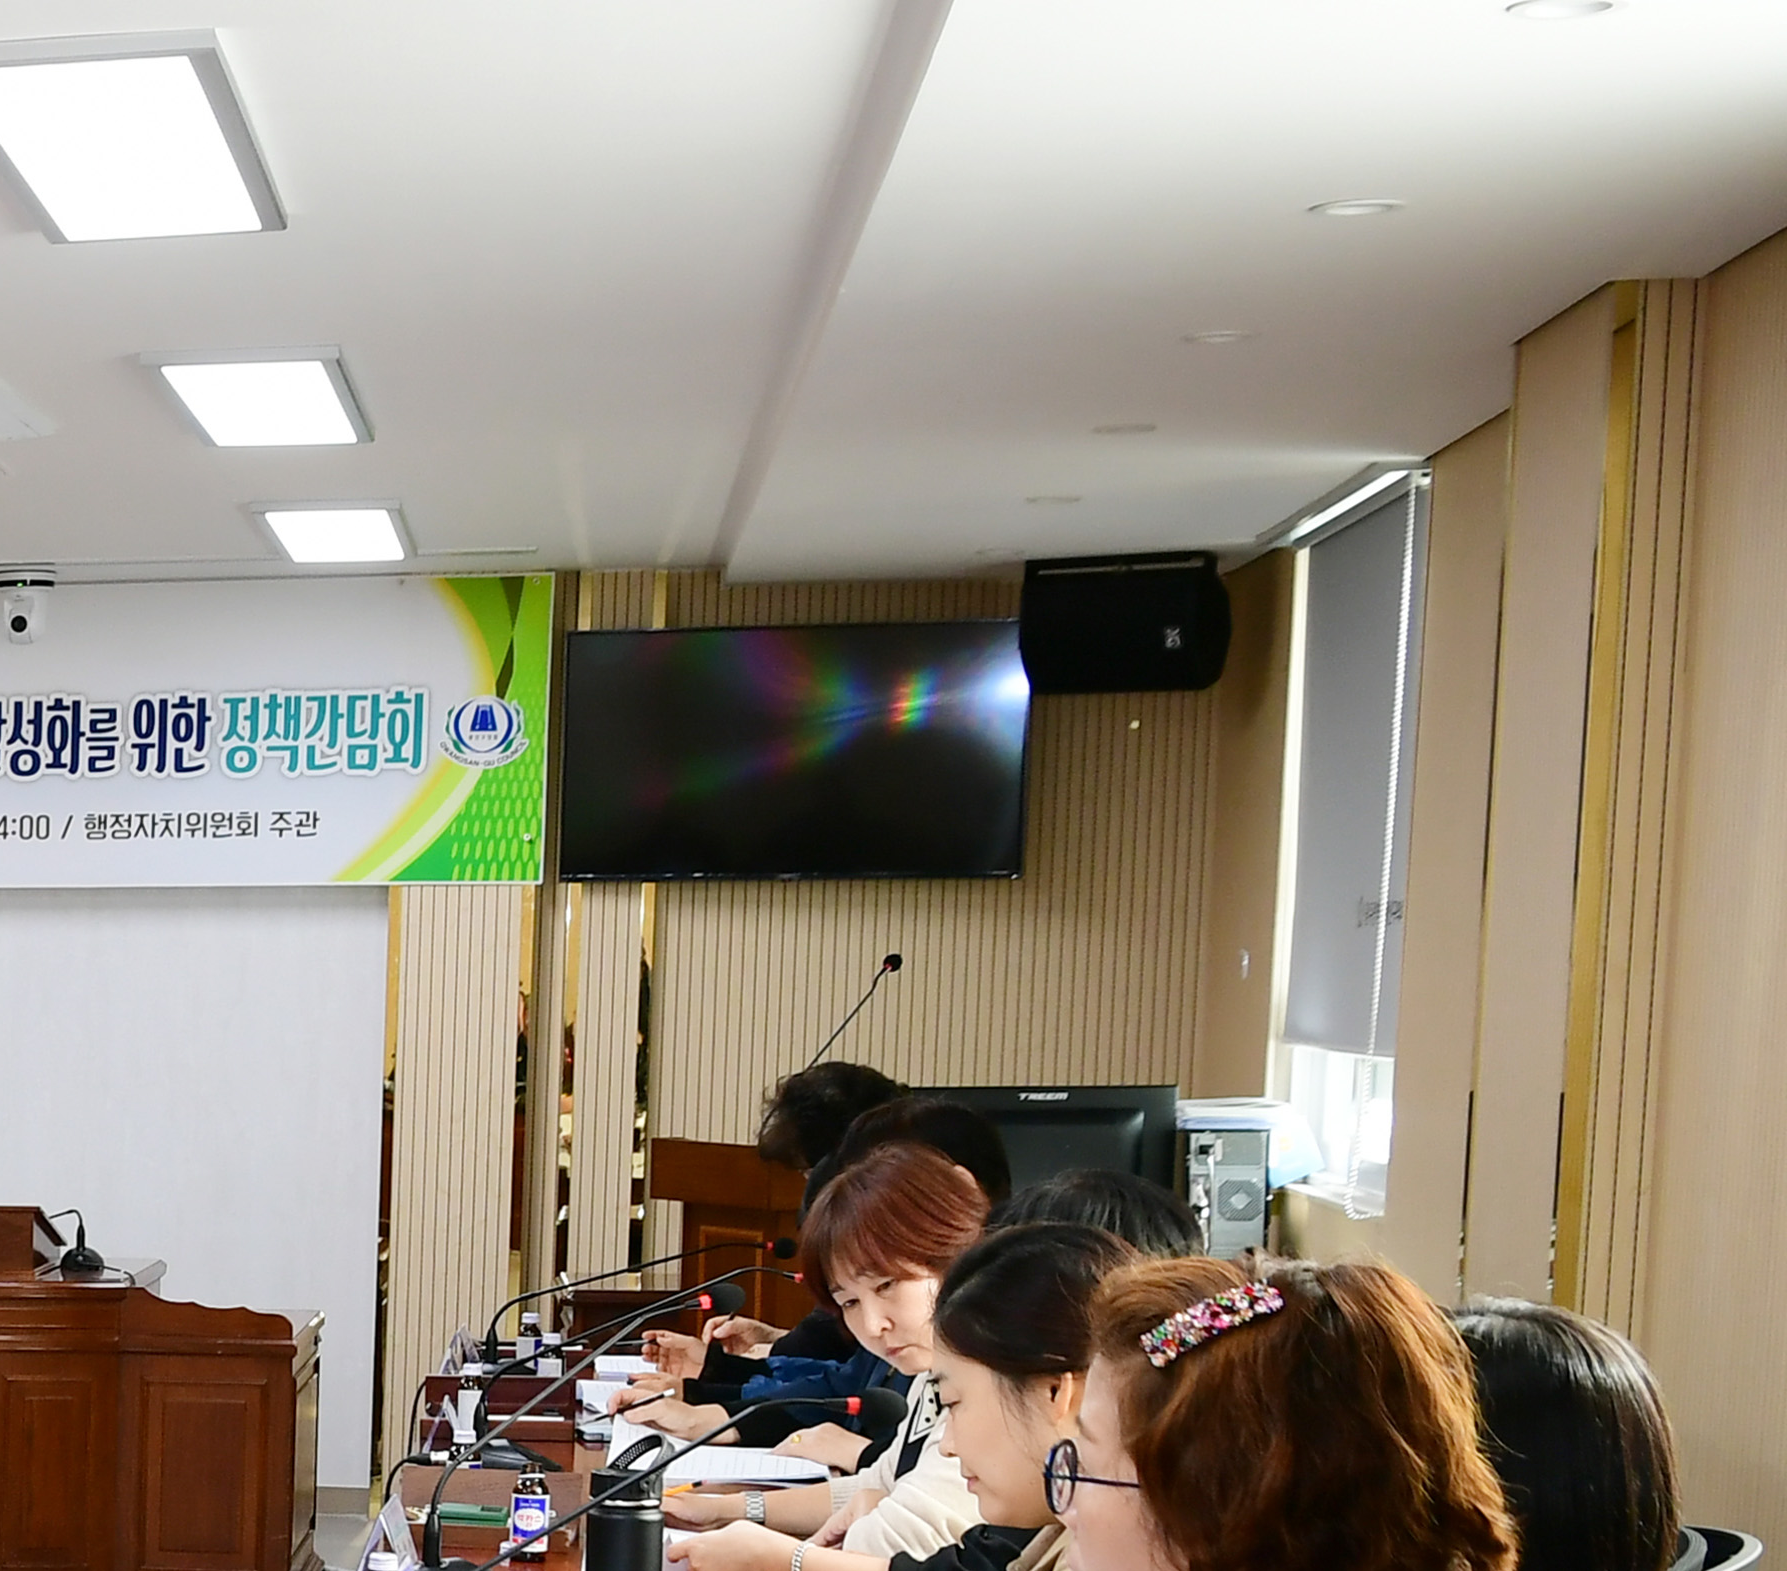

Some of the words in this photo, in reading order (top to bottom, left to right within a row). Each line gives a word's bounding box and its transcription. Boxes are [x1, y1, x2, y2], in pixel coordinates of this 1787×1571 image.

[130, 695, 212, 774] 위한
[221, 690, 425, 775] 정책간담회
[82, 811, 260, 840] 행정자치위원회
[269, 810, 320, 838] 주관
